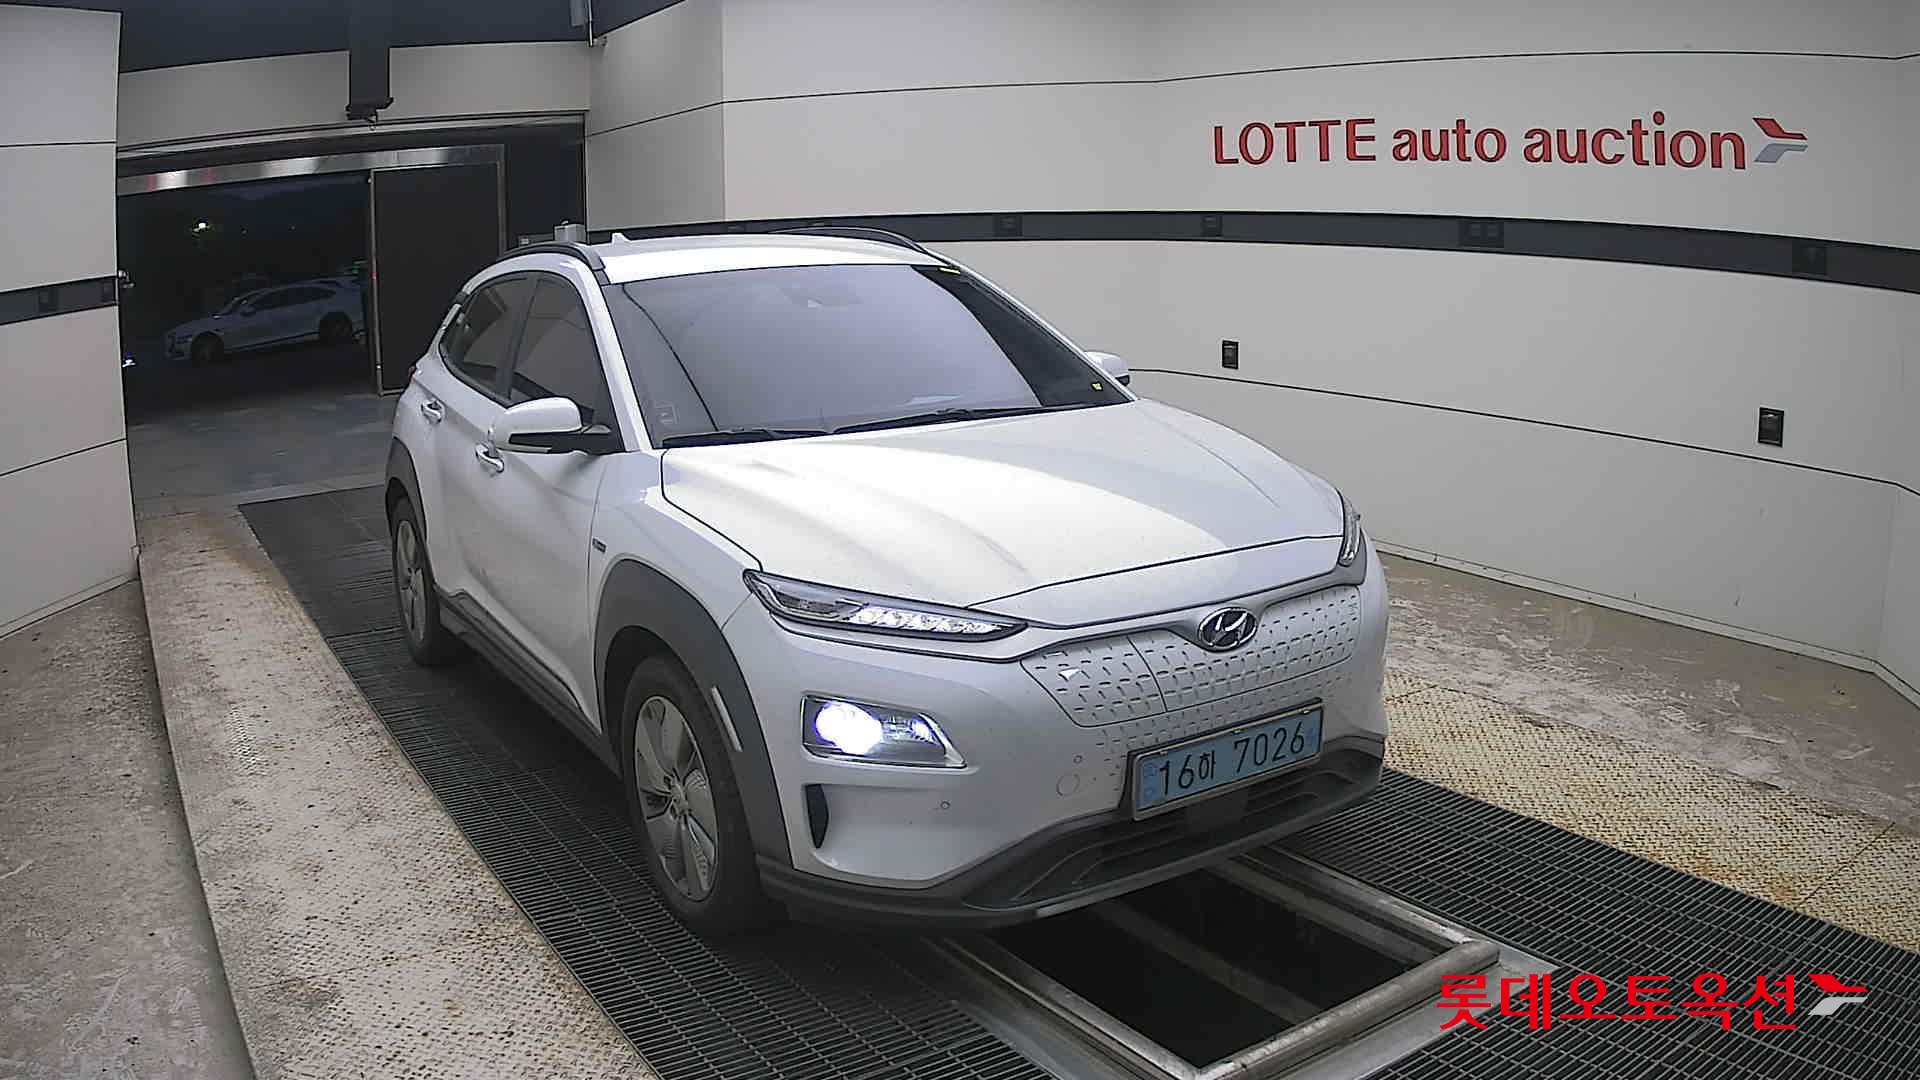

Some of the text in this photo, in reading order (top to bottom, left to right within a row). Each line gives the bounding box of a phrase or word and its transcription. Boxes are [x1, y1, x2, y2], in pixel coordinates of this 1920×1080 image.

[1213, 110, 1746, 169] LOTTE auto auction
[1159, 721, 1305, 796] 16하 7026
